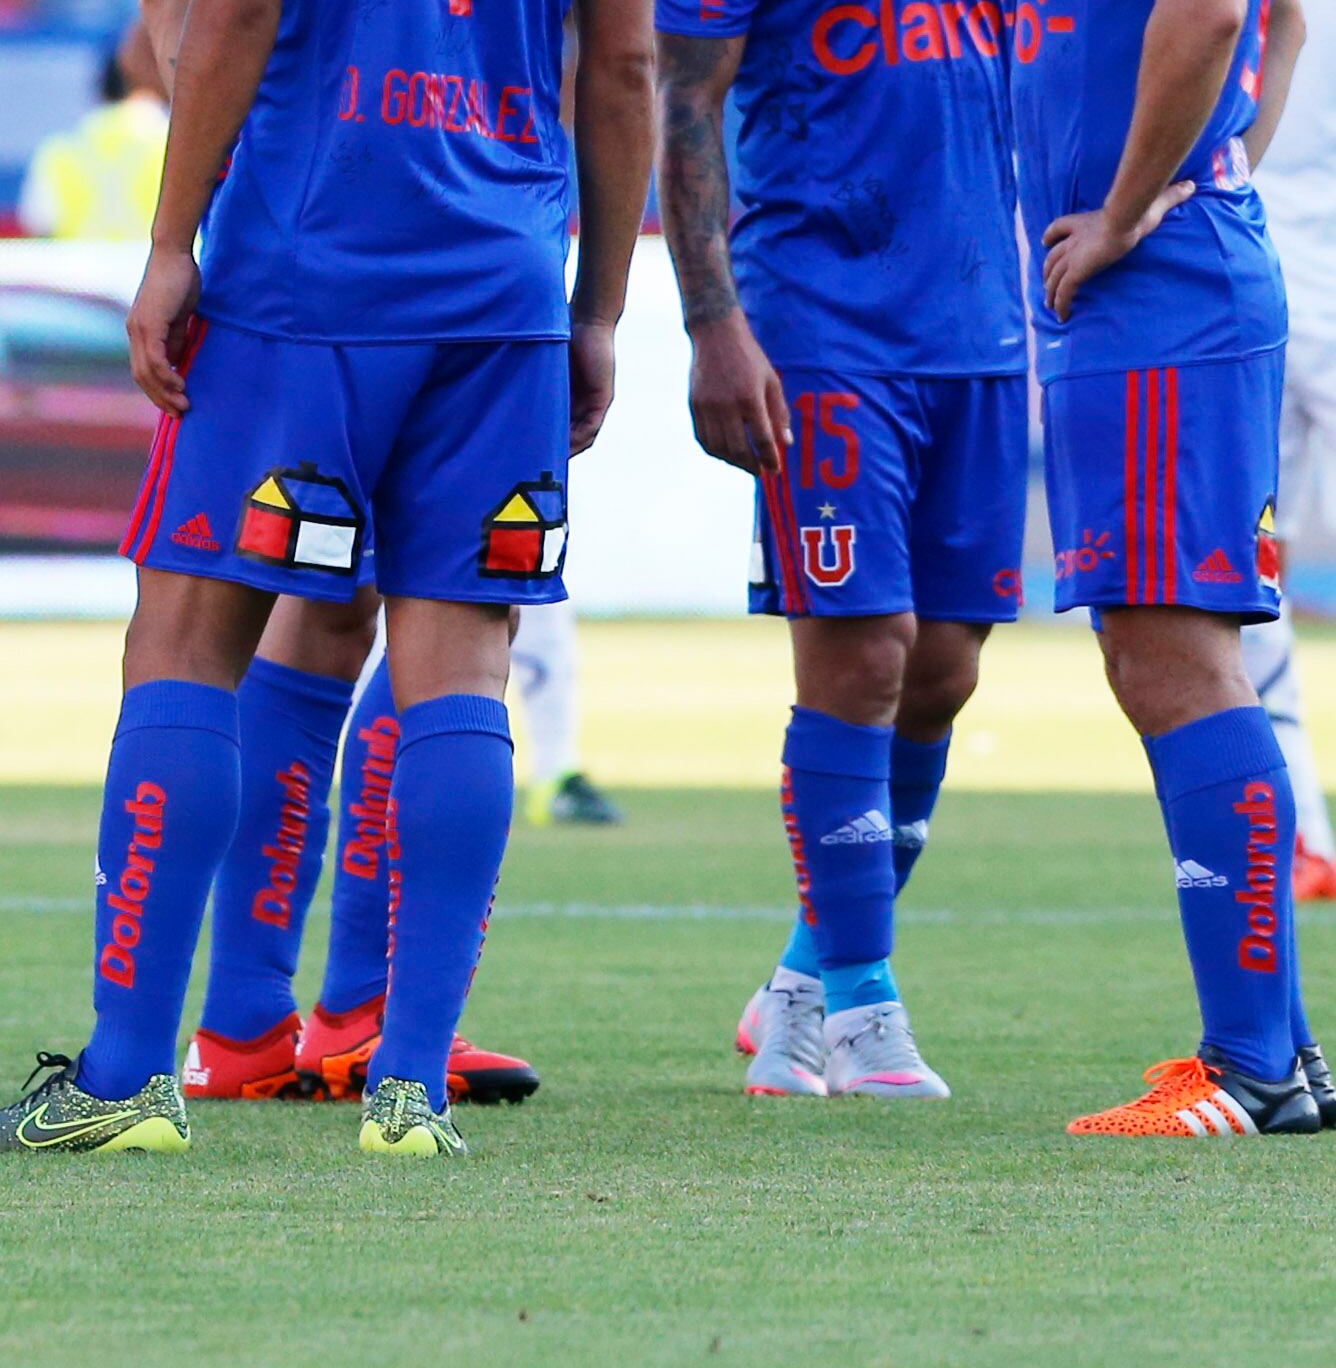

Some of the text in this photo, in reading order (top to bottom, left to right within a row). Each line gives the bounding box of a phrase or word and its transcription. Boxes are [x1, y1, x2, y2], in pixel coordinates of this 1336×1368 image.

[794, 392, 861, 489] 15
[800, 525, 856, 588] U
[99, 780, 167, 989] Dolorub
[1232, 780, 1279, 974] Dolorub
